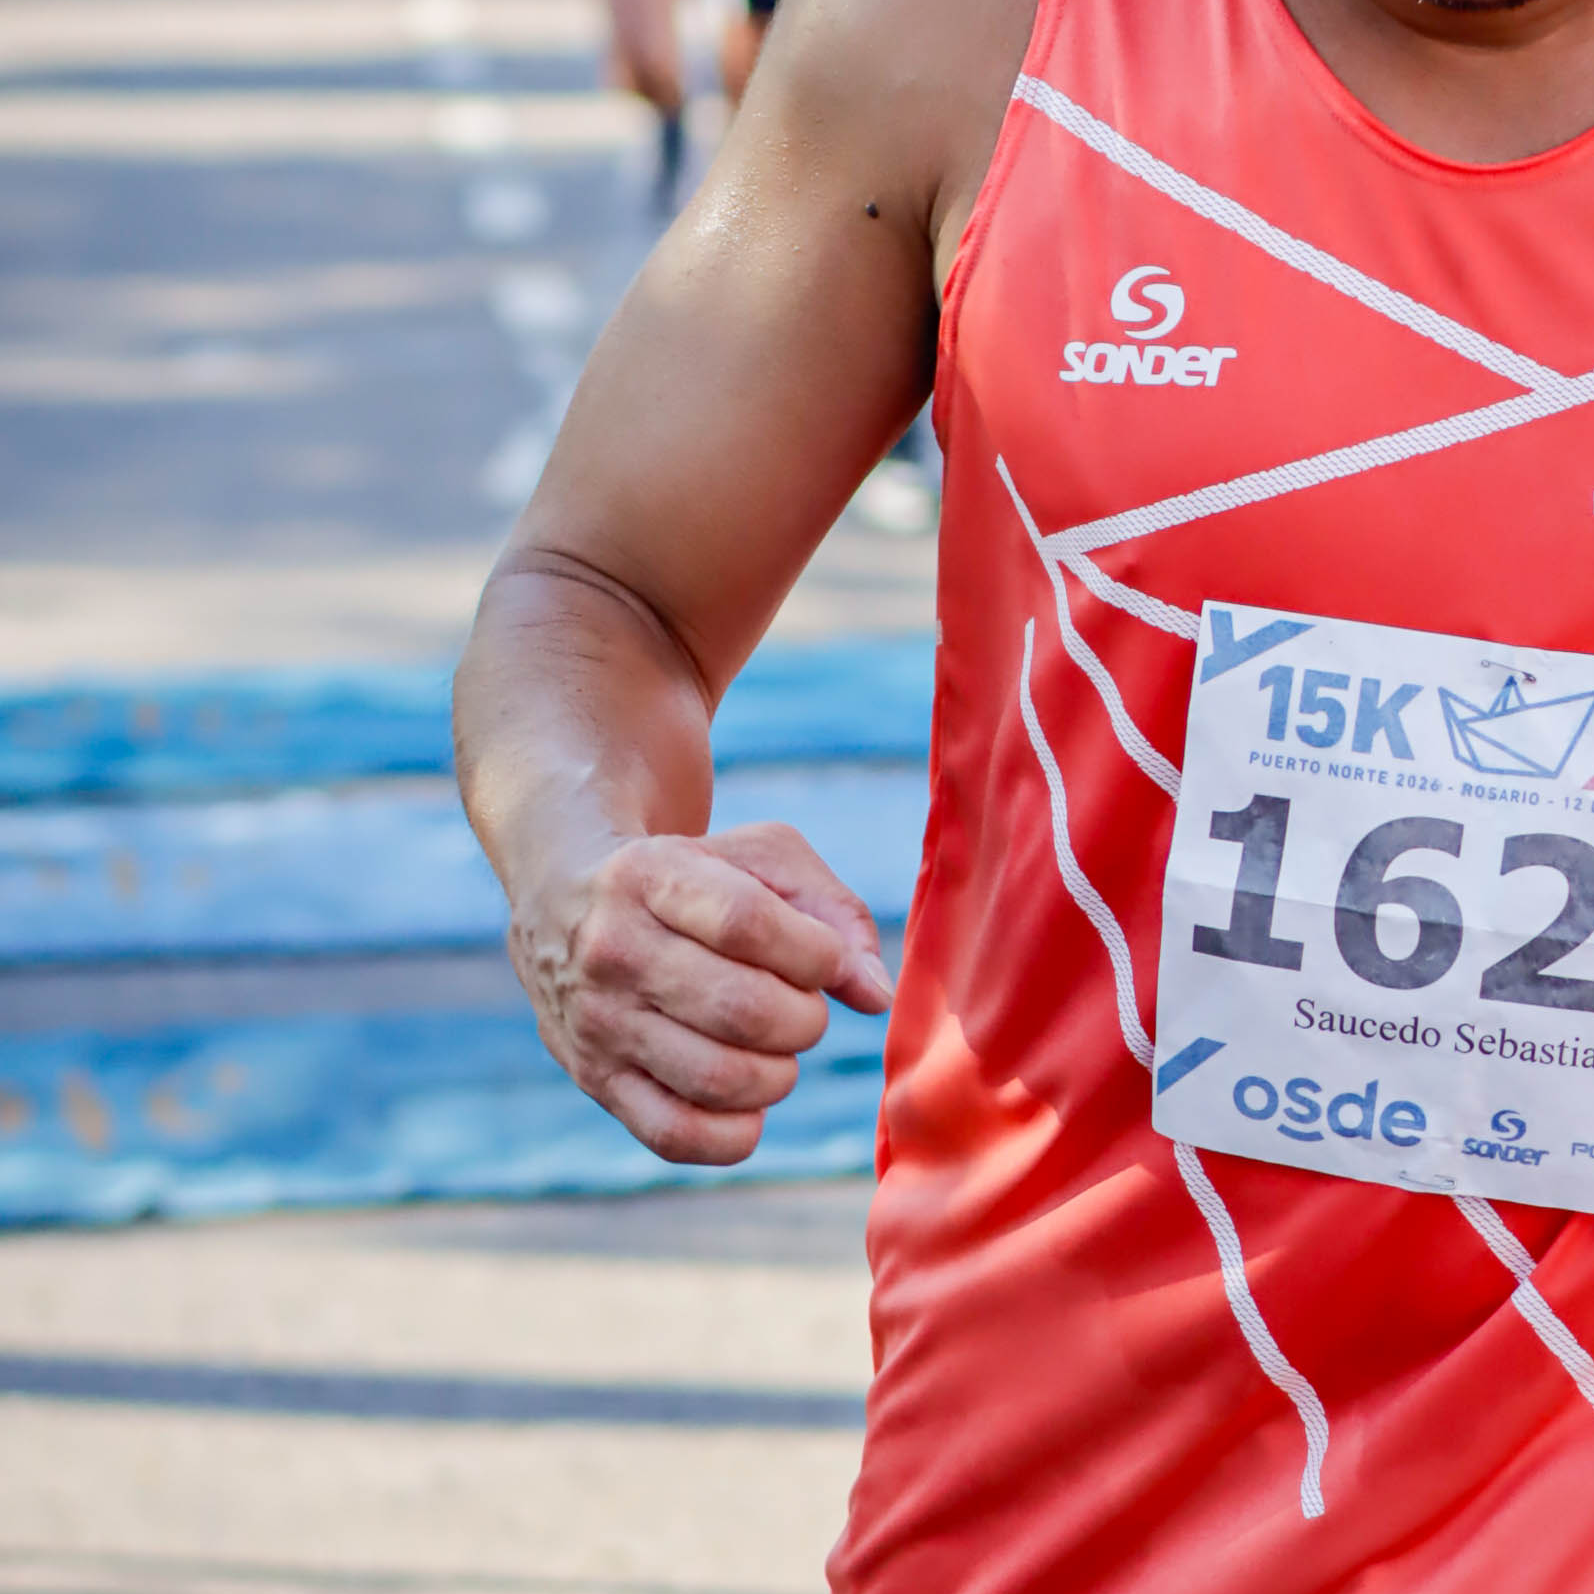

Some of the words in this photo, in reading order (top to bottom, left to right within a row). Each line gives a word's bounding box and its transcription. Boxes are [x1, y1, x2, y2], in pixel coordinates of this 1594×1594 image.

[1258, 664, 1424, 761] 15K
[1249, 751, 1321, 774] PUERTO
[1328, 762, 1389, 785] NORTE
[1395, 773, 1441, 793] 2026
[1460, 782, 1541, 806] ROSARIO
[1564, 796, 1583, 811] 12
[1294, 998, 1441, 1048] Saucedo
[1232, 1074, 1427, 1148] osde
